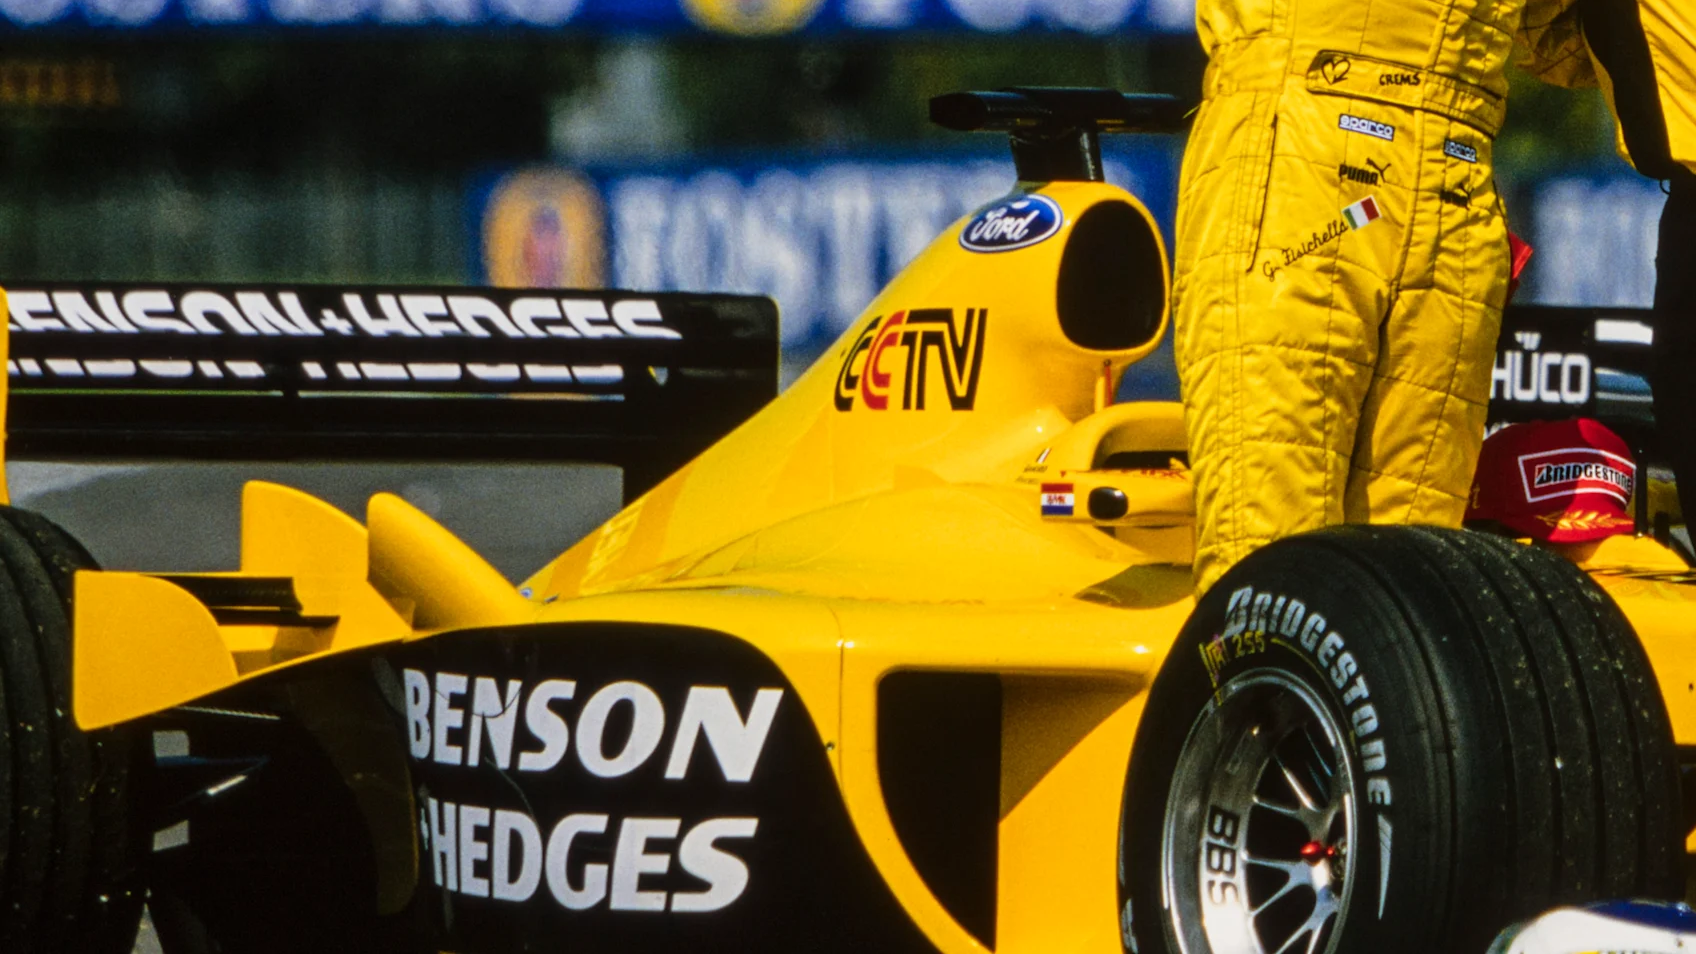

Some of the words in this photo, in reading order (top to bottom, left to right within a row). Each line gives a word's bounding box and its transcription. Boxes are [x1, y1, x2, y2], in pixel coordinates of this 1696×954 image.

[1379, 74, 1421, 86] CREMS
[969, 200, 1040, 242] Ford
[1339, 164, 1379, 186] PUMA
[833, 307, 988, 412] CCTV
[1534, 463, 1633, 495] BRIDGESTONE
[403, 667, 784, 782] BENSON
[1221, 586, 1393, 806] BRIDGESTONE
[428, 797, 760, 913] HEDGES
[1206, 805, 1241, 906] BBS
